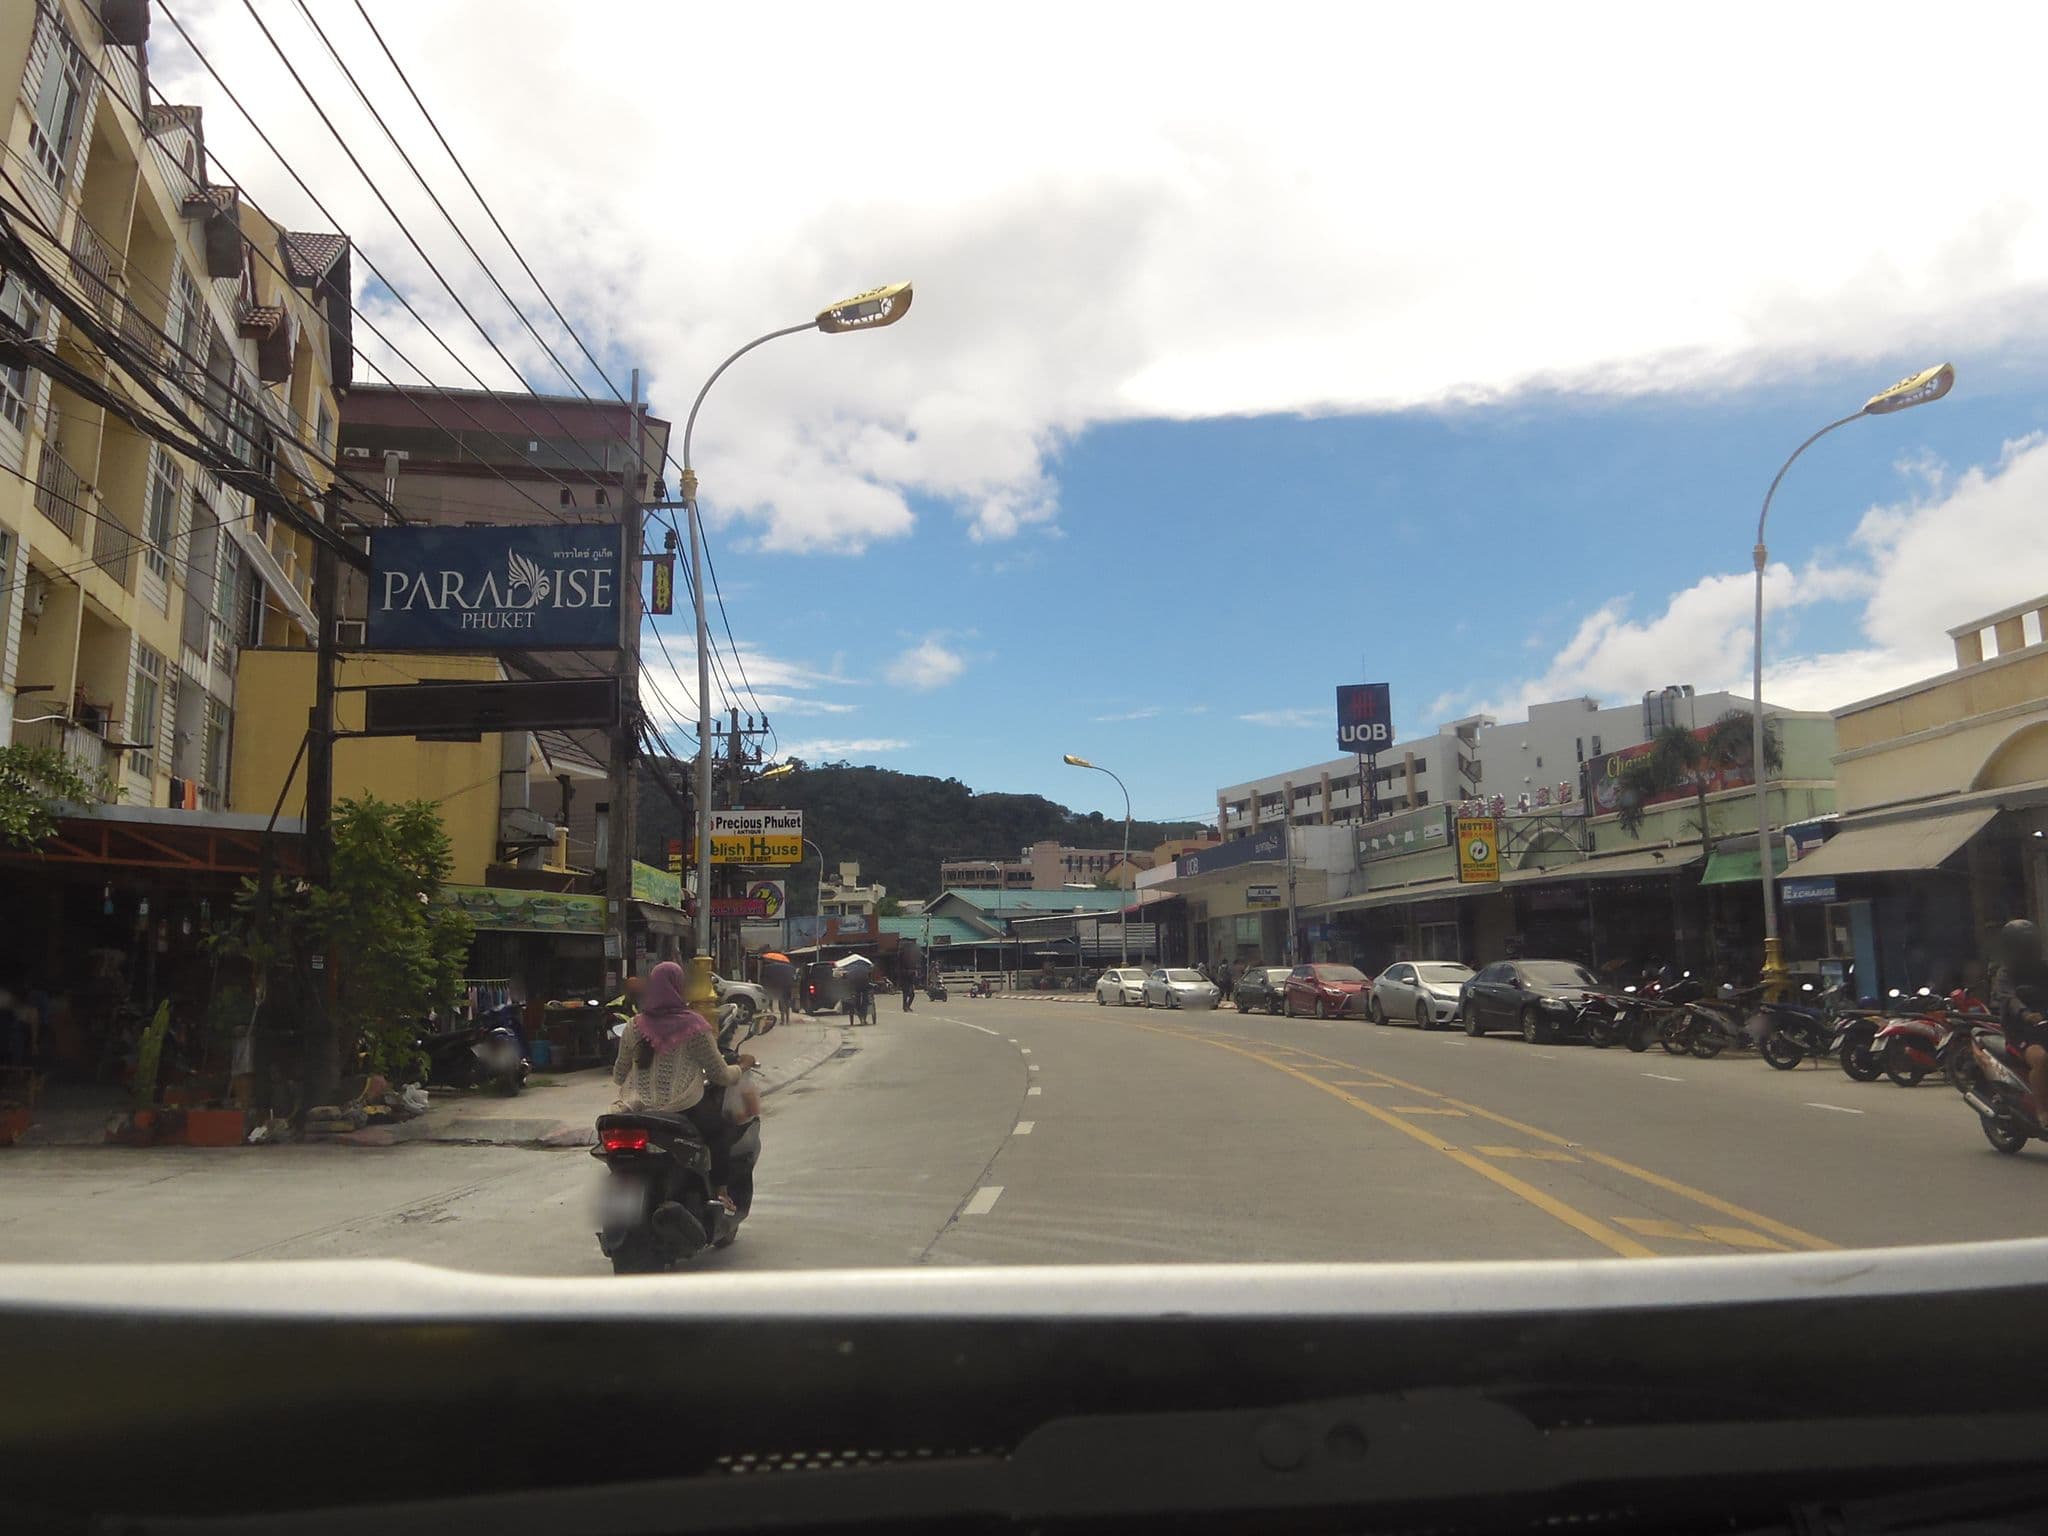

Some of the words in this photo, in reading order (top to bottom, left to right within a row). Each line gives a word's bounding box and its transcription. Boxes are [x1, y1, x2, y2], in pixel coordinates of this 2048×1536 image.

[381, 557, 613, 611] PARADISE
[461, 611, 536, 629] PHUKET
[1341, 723, 1388, 742] UOB
[715, 815, 762, 829] Precious
[763, 815, 801, 829] Phuket
[749, 837, 798, 856] House
